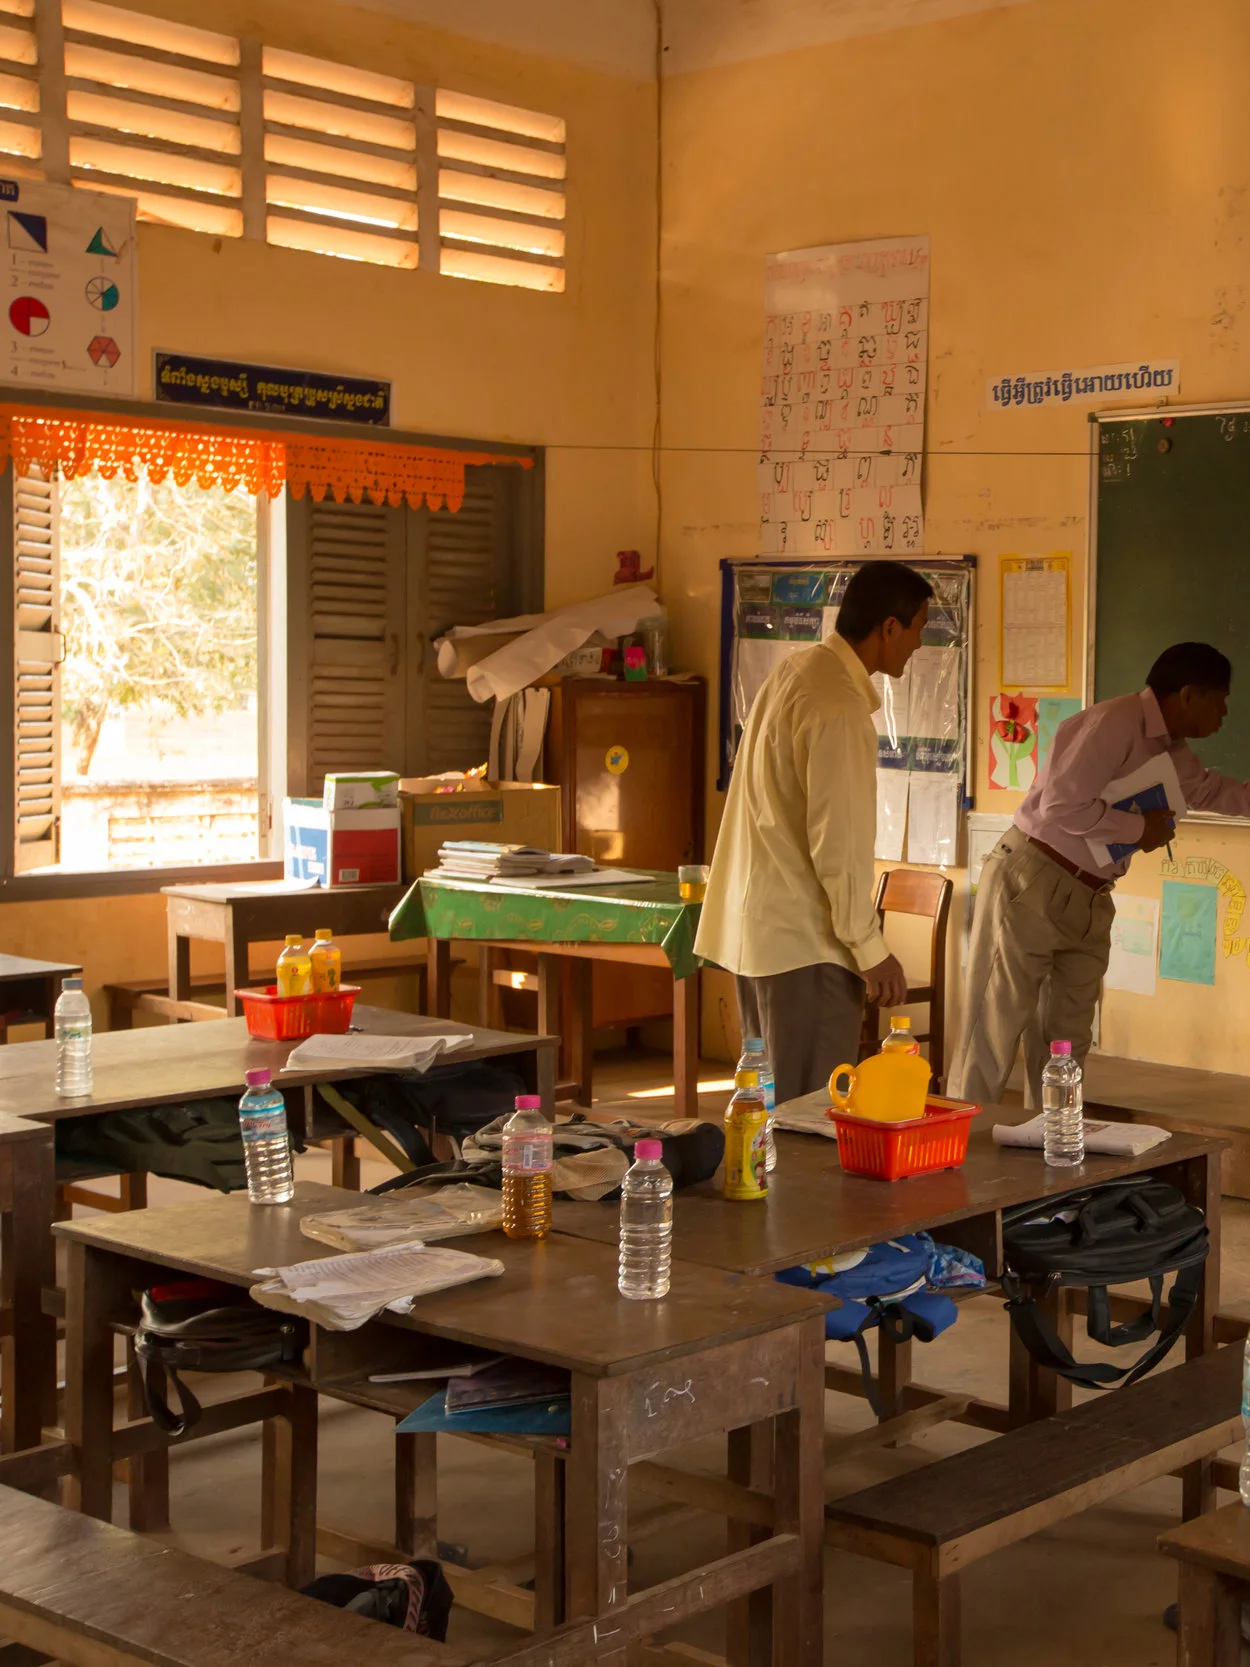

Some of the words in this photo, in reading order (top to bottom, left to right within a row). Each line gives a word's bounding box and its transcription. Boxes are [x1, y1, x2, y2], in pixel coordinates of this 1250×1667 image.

[992, 365, 1173, 406] ធ្វើអ្វីត្រូវធ្វើអោយហើយ
